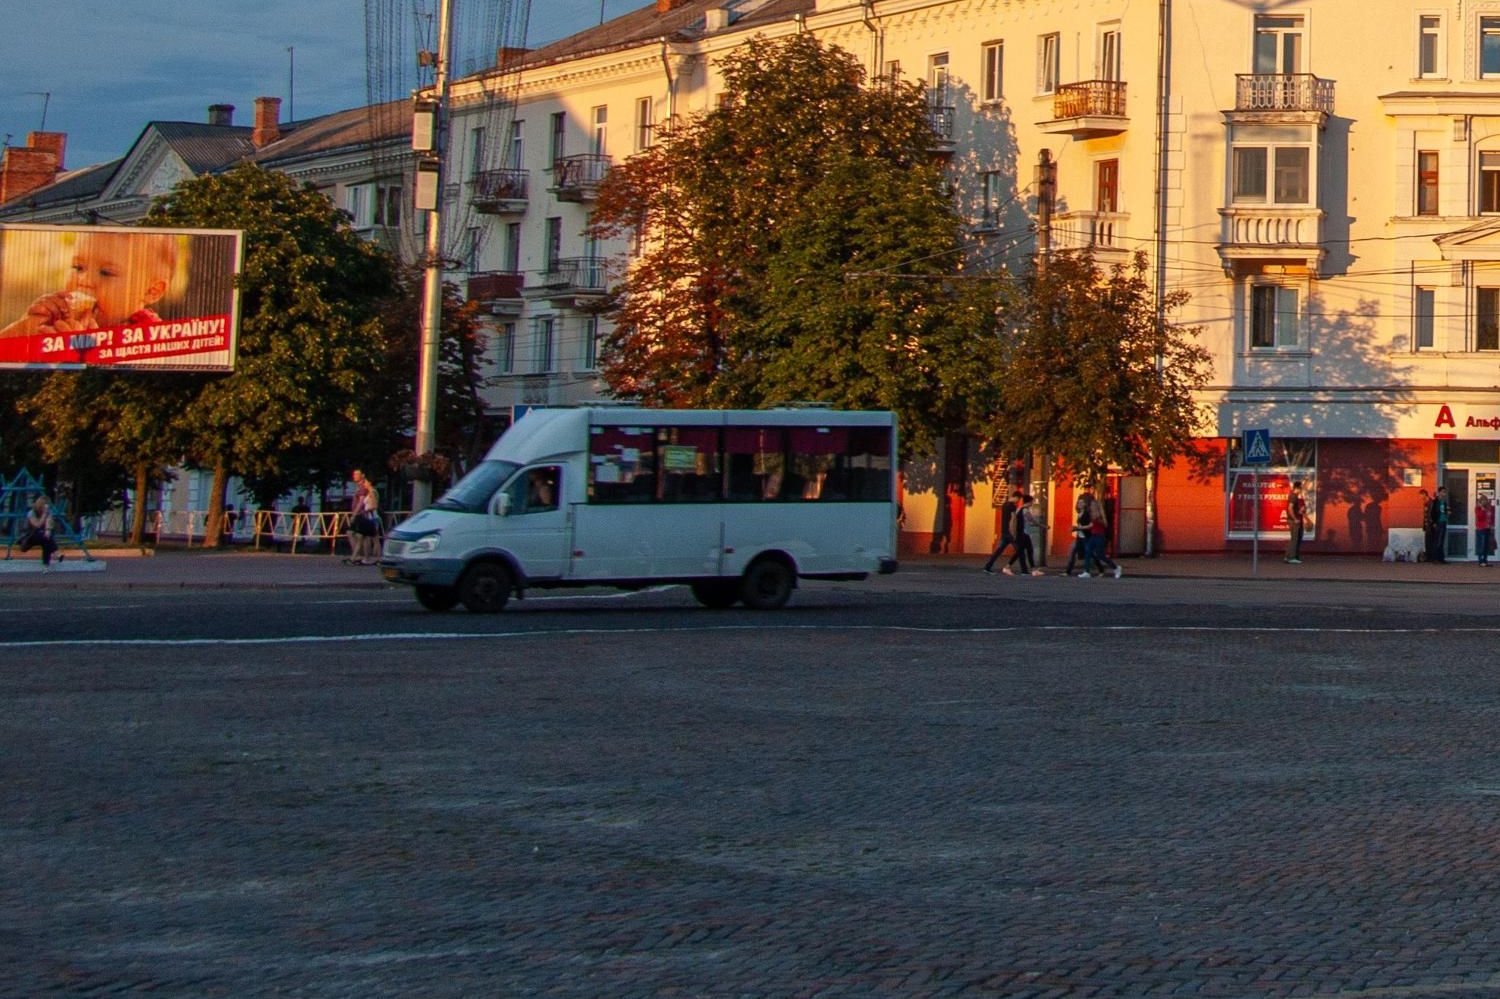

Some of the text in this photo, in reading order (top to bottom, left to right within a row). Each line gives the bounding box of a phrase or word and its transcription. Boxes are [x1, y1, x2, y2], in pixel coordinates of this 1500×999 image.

[42, 318, 225, 353] ЗА МИР! ЗА УКРАЇНУ!
[99, 349, 112, 359] ЗА
[115, 345, 151, 358] ЩАСТЯ
[153, 341, 190, 353] НАШИХ
